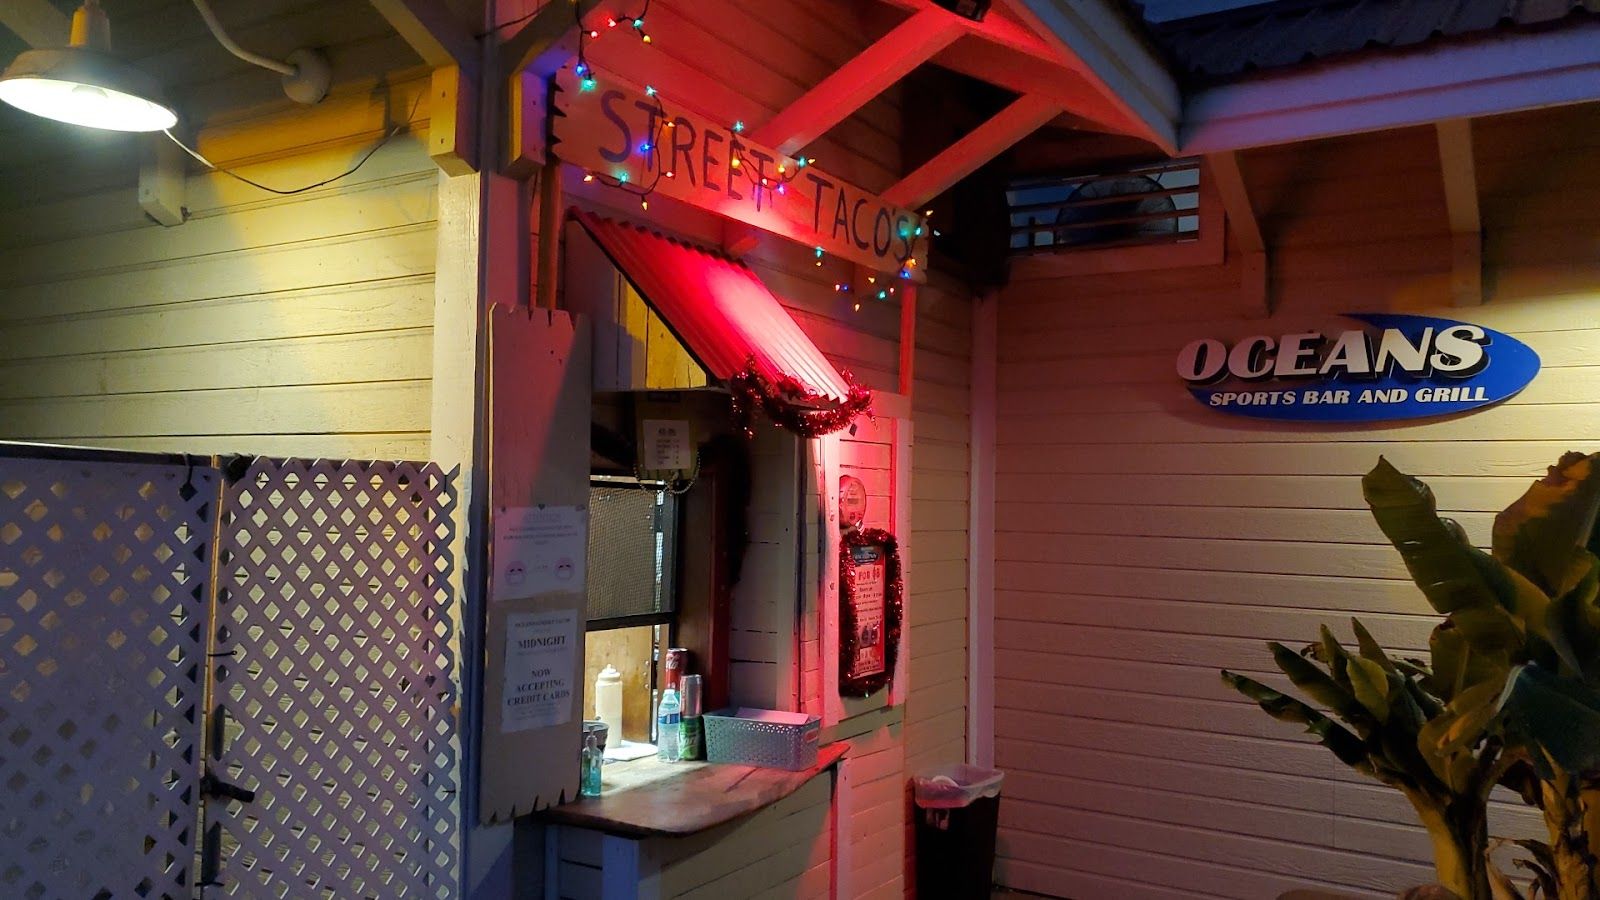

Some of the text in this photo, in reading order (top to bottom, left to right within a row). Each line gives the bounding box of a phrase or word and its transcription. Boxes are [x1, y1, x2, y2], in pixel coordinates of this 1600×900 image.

[598, 90, 774, 212] STREET
[1176, 325, 1487, 381] OCEANS
[1210, 386, 1489, 406] SPORTS BAR AND GRILL
[517, 635, 566, 649] MIDNIGHT
[531, 668, 551, 678] NOW
[516, 679, 565, 692] ACCEPTING
[507, 689, 570, 706] CREDIT CARDS
